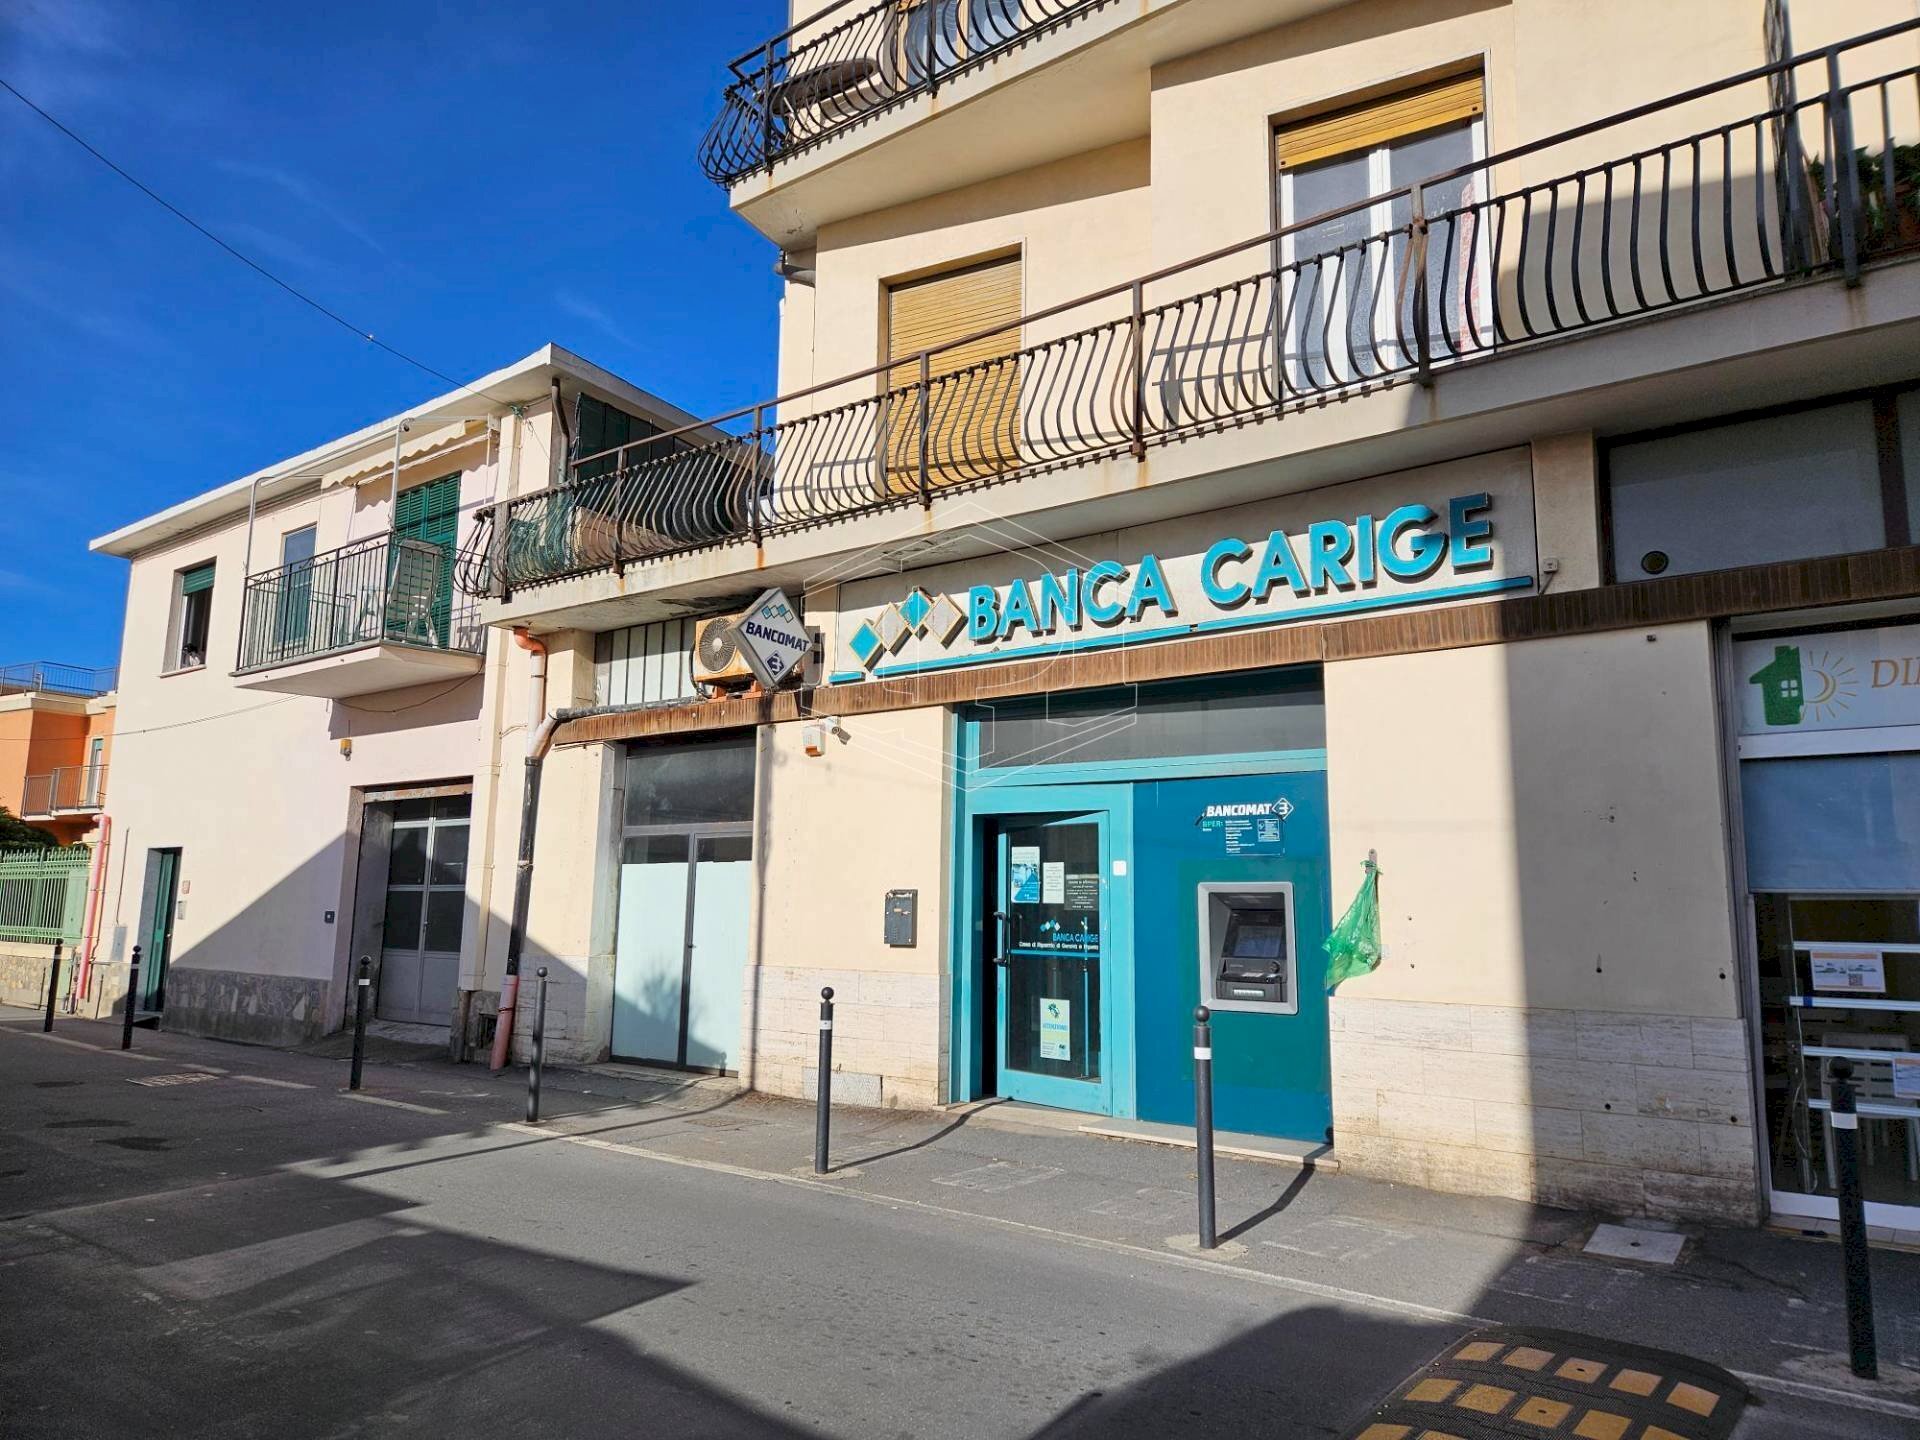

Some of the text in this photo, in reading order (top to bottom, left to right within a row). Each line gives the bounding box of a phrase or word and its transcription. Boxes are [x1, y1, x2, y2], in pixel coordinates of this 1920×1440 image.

[969, 492, 1493, 644] BANCA CARIGE
[746, 622, 809, 652] BANCOMAT
[1206, 803, 1272, 817] BANCOMAT
[1053, 933, 1074, 942] BANCA
